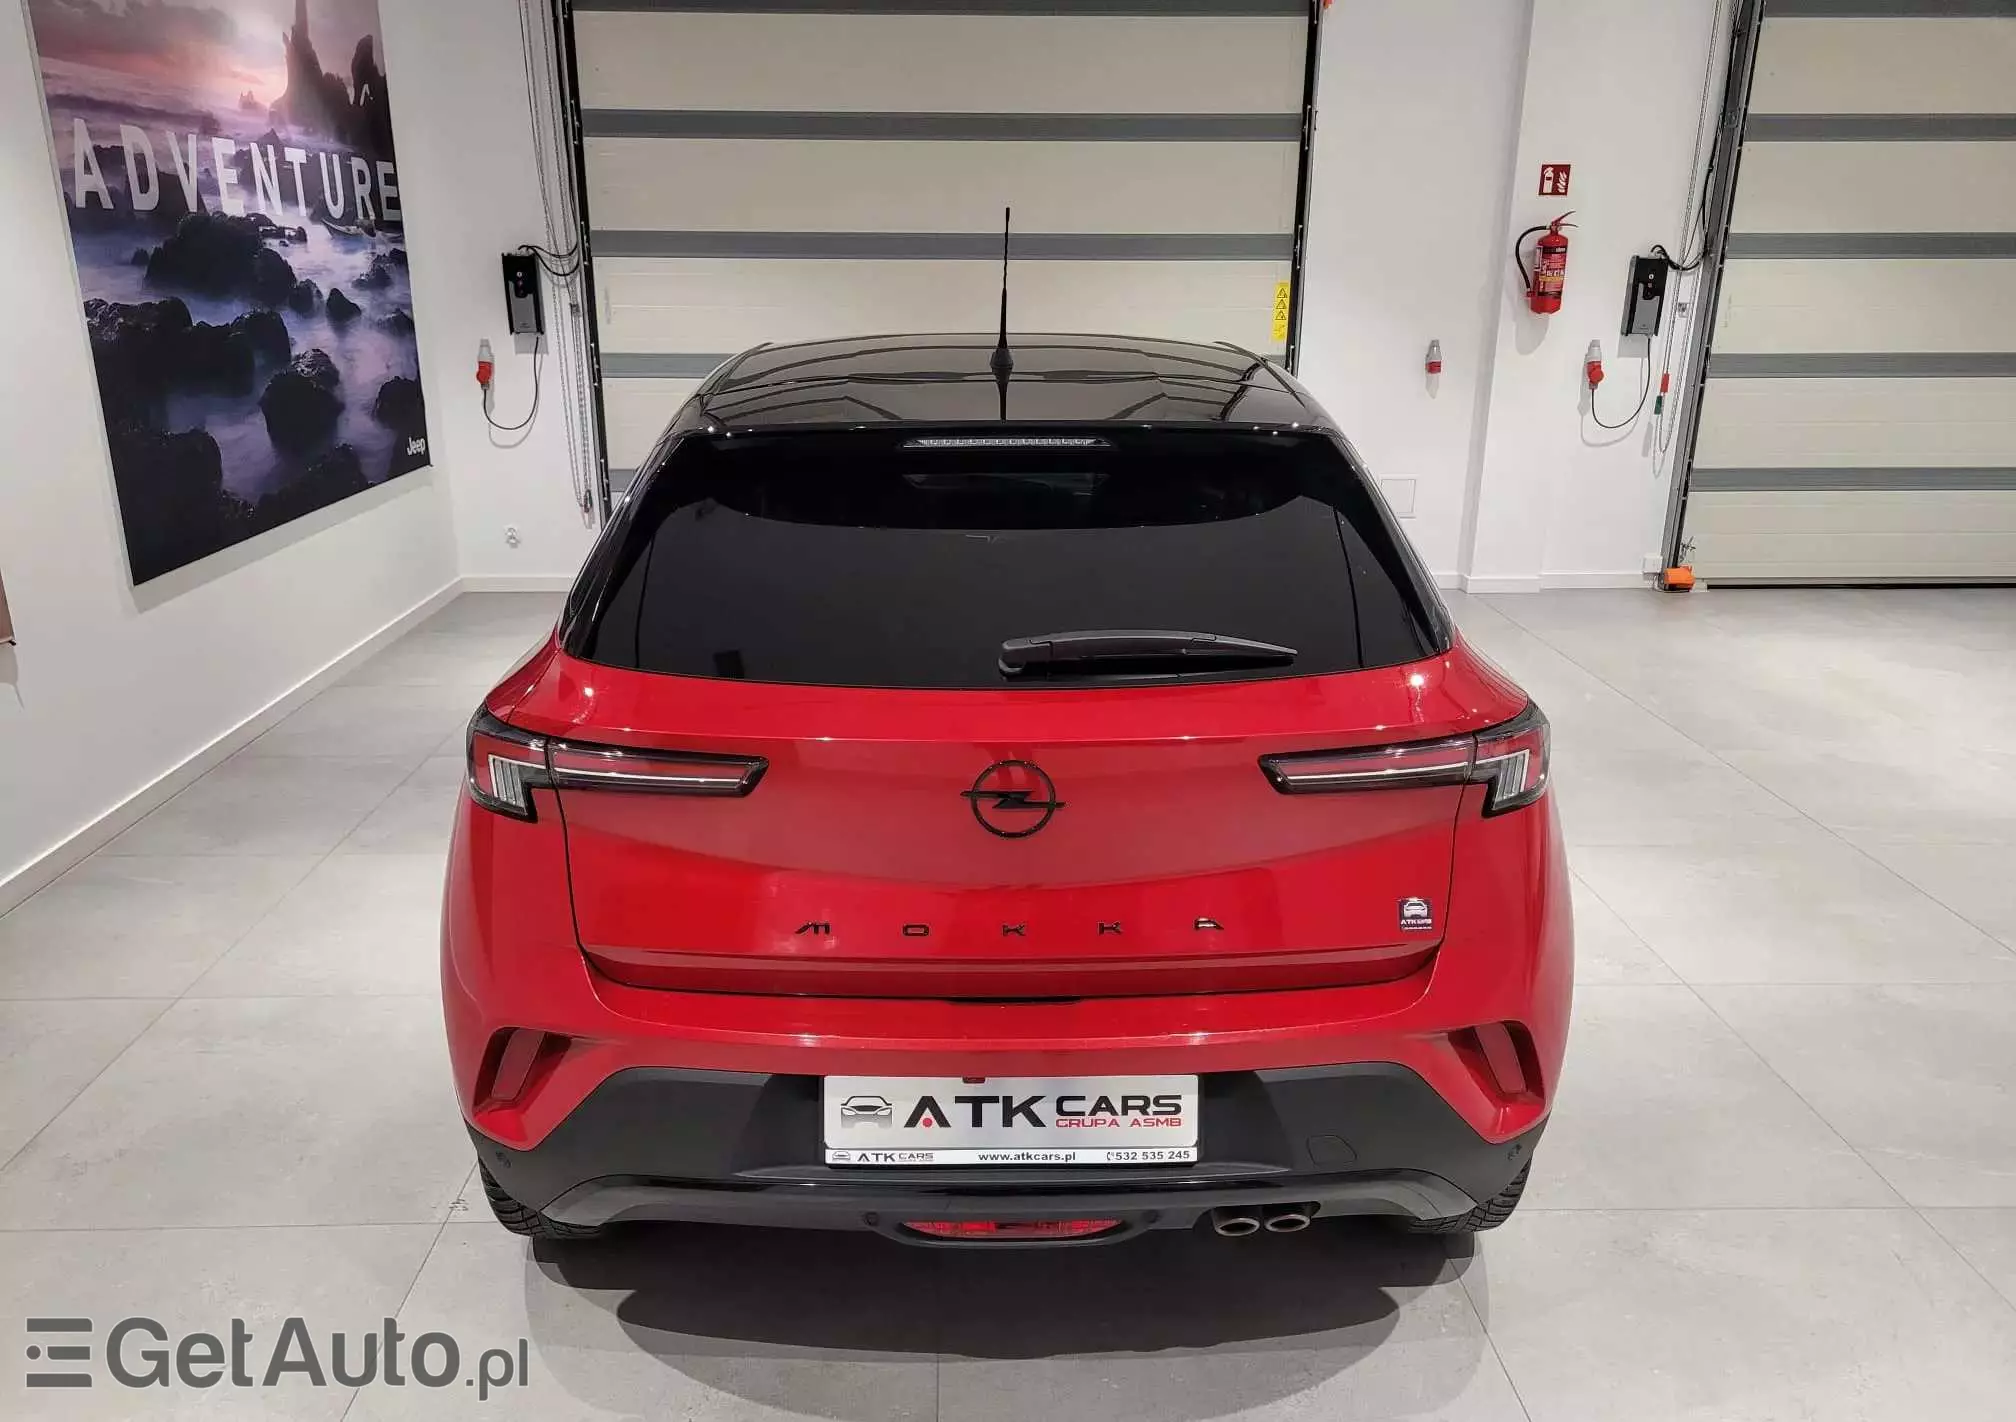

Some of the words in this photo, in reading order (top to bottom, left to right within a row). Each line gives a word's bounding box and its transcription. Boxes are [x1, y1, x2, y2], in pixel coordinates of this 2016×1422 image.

[74, 118, 401, 221] ADVENTURE
[406, 436, 426, 456] Jeep
[795, 917, 1225, 937] MOKKA
[904, 1095, 1046, 1128] ATK
[1056, 1095, 1182, 1116] CARS
[1056, 1118, 1120, 1128] GRUPA
[1130, 1118, 1182, 1127] ASMB
[857, 1153, 897, 1163] ATK
[898, 1152, 934, 1160] CARS
[977, 1151, 1076, 1163] www.atkcars.pl
[1115, 1151, 1137, 1161] 532
[1142, 1151, 1164, 1161] 535
[1168, 1150, 1190, 1160] 245
